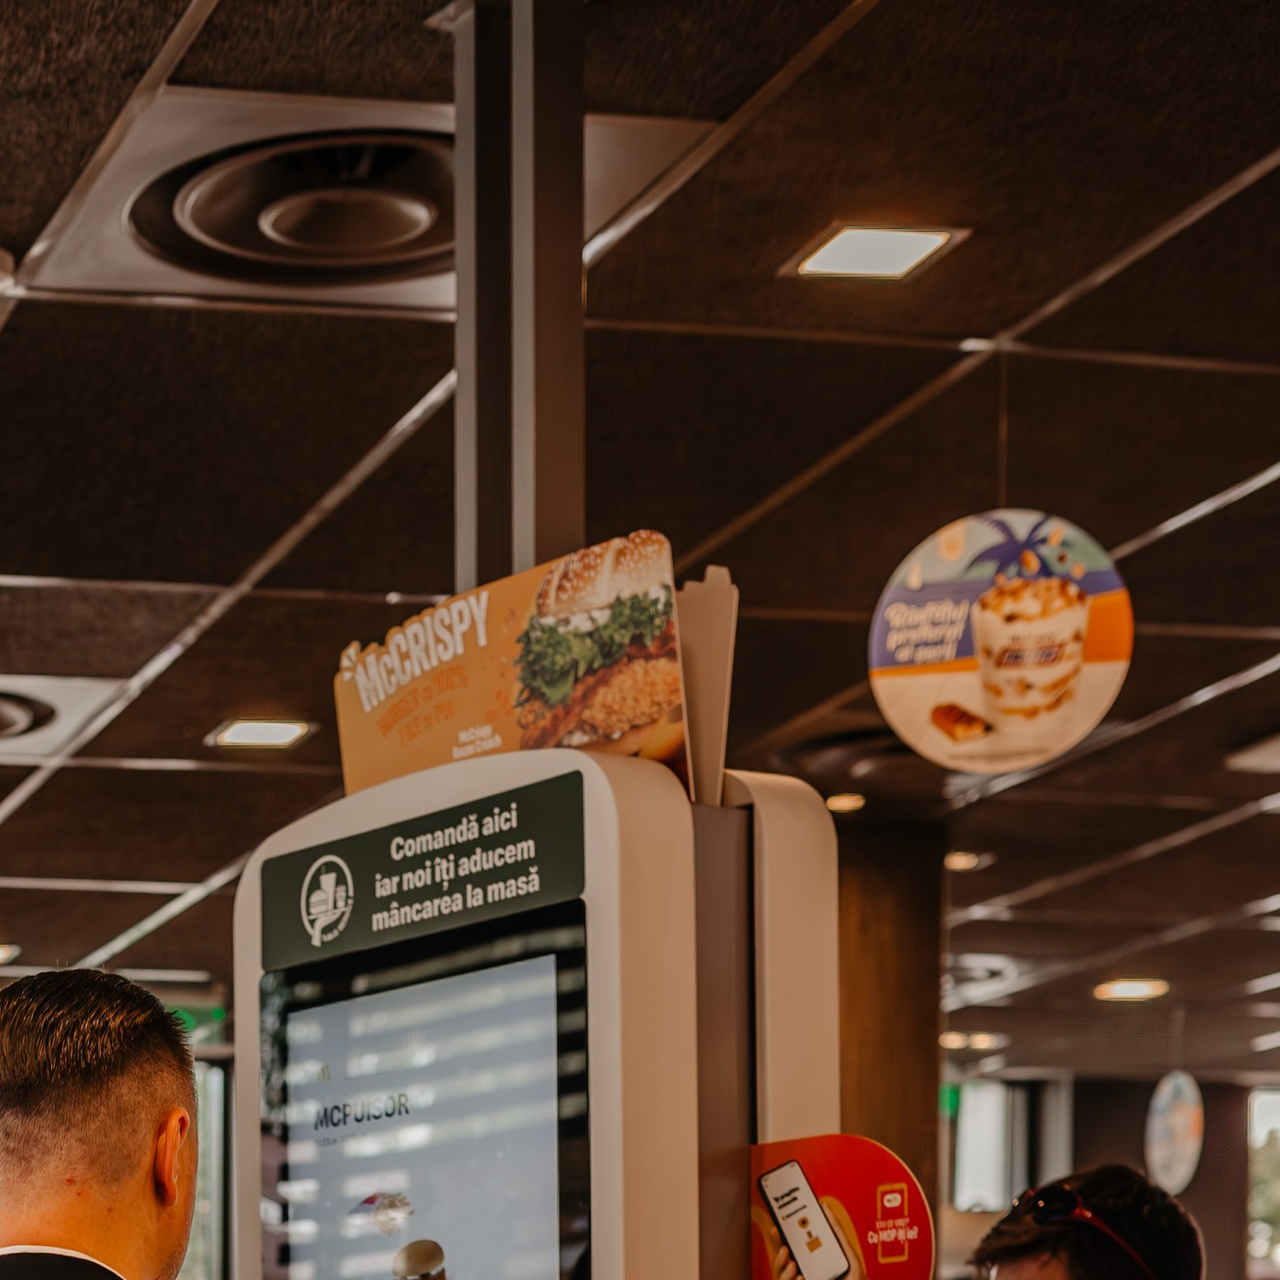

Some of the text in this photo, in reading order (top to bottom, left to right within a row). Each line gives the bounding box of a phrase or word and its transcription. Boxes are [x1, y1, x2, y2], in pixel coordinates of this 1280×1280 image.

[355, 590, 489, 713] McCRISPY
[390, 802, 517, 860] Comandă aici
[372, 892, 463, 931] mâncarea
[466, 884, 484, 908] la
[487, 865, 540, 904] masă
[375, 839, 535, 898] iar noi îți aducem
